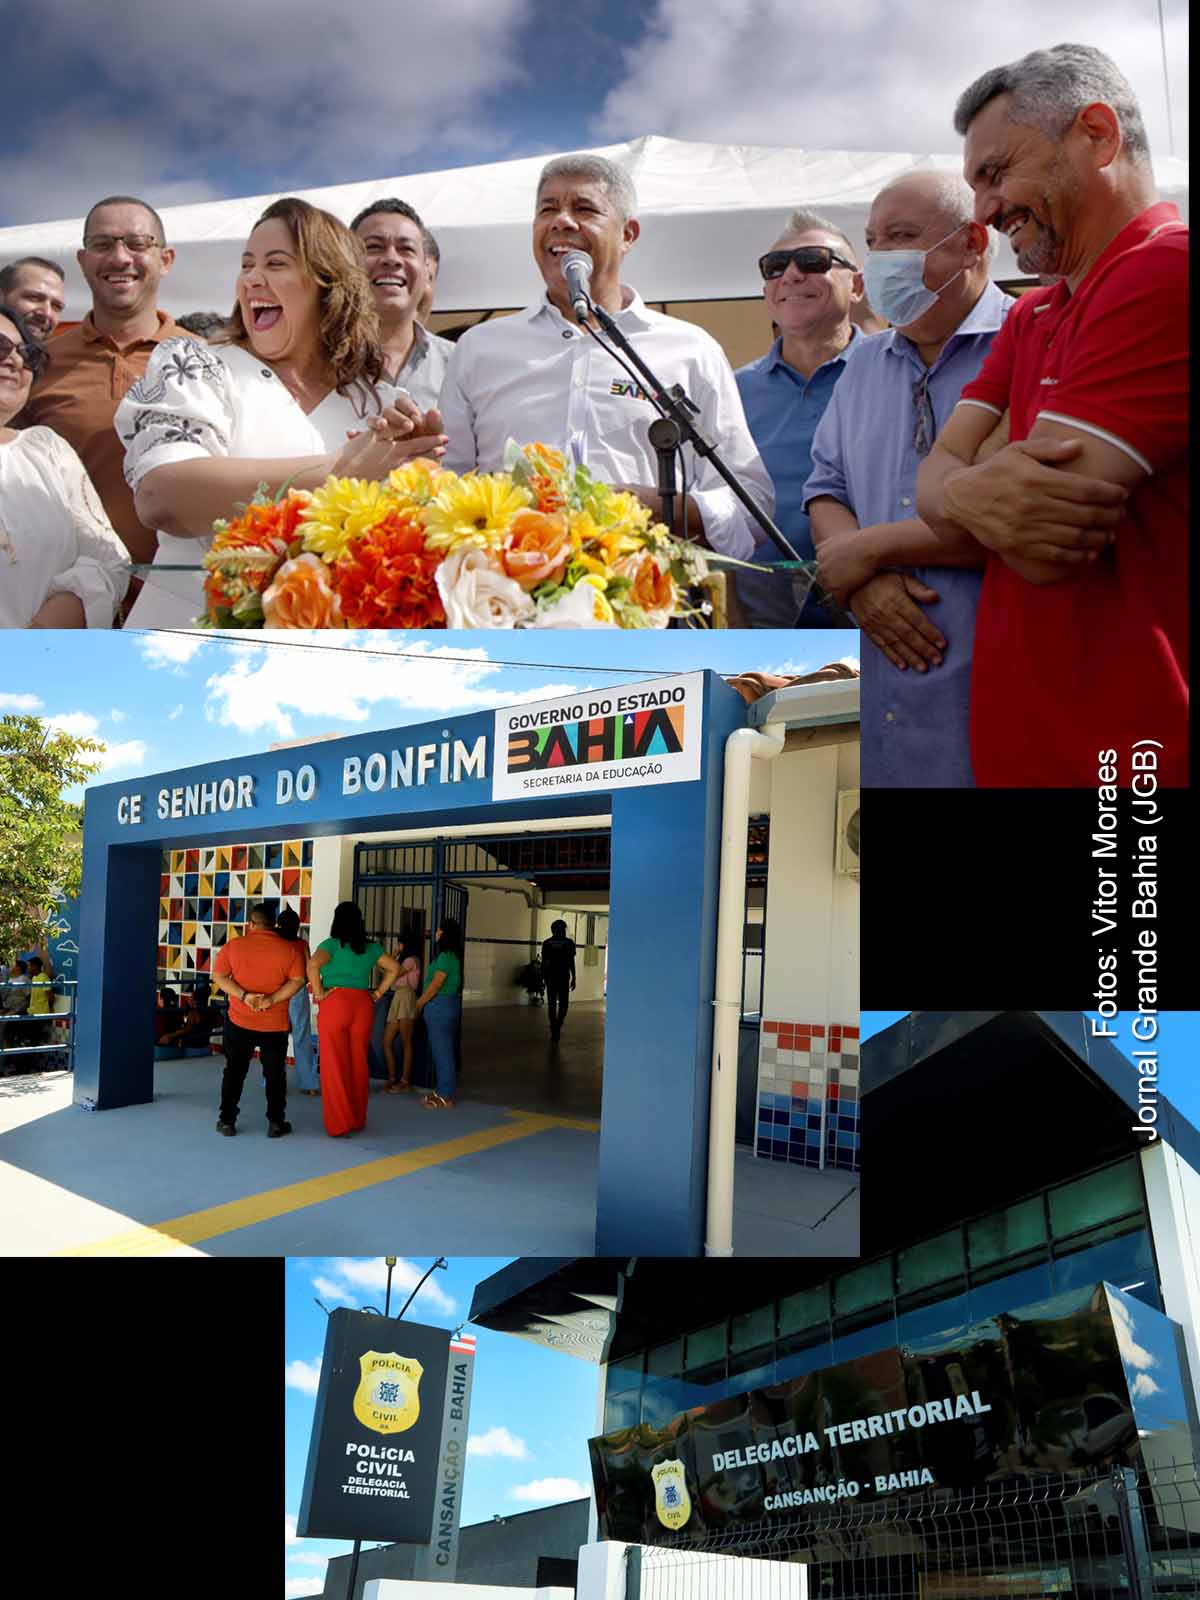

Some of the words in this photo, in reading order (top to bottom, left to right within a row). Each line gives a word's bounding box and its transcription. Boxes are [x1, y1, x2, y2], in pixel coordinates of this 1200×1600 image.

[508, 704, 584, 730] GOVERNO
[588, 699, 612, 718] DO
[617, 686, 686, 712] ESTADO
[506, 705, 685, 774] BAHIA
[117, 794, 143, 826] CE
[157, 774, 256, 821] SENHOR
[276, 764, 318, 806] DO
[523, 771, 583, 789] SECRETARIA
[585, 769, 600, 781] DA
[602, 763, 663, 780] EDUCAÇÃO
[372, 1411, 399, 1422] CIVIL
[711, 1432, 819, 1472] DELEGACIA
[824, 1390, 992, 1448] TERRITORIAL
[348, 1476, 407, 1490] DELEGACIA
[356, 1460, 402, 1477] CIVIL
[436, 1439, 459, 1567] CANSANÇÃO
[450, 1363, 468, 1421] BAHIA
[341, 1485, 411, 1499] TERRITORIAL
[763, 1478, 860, 1511] CANSANÇÃO
[875, 1468, 935, 1493] BAHIA
